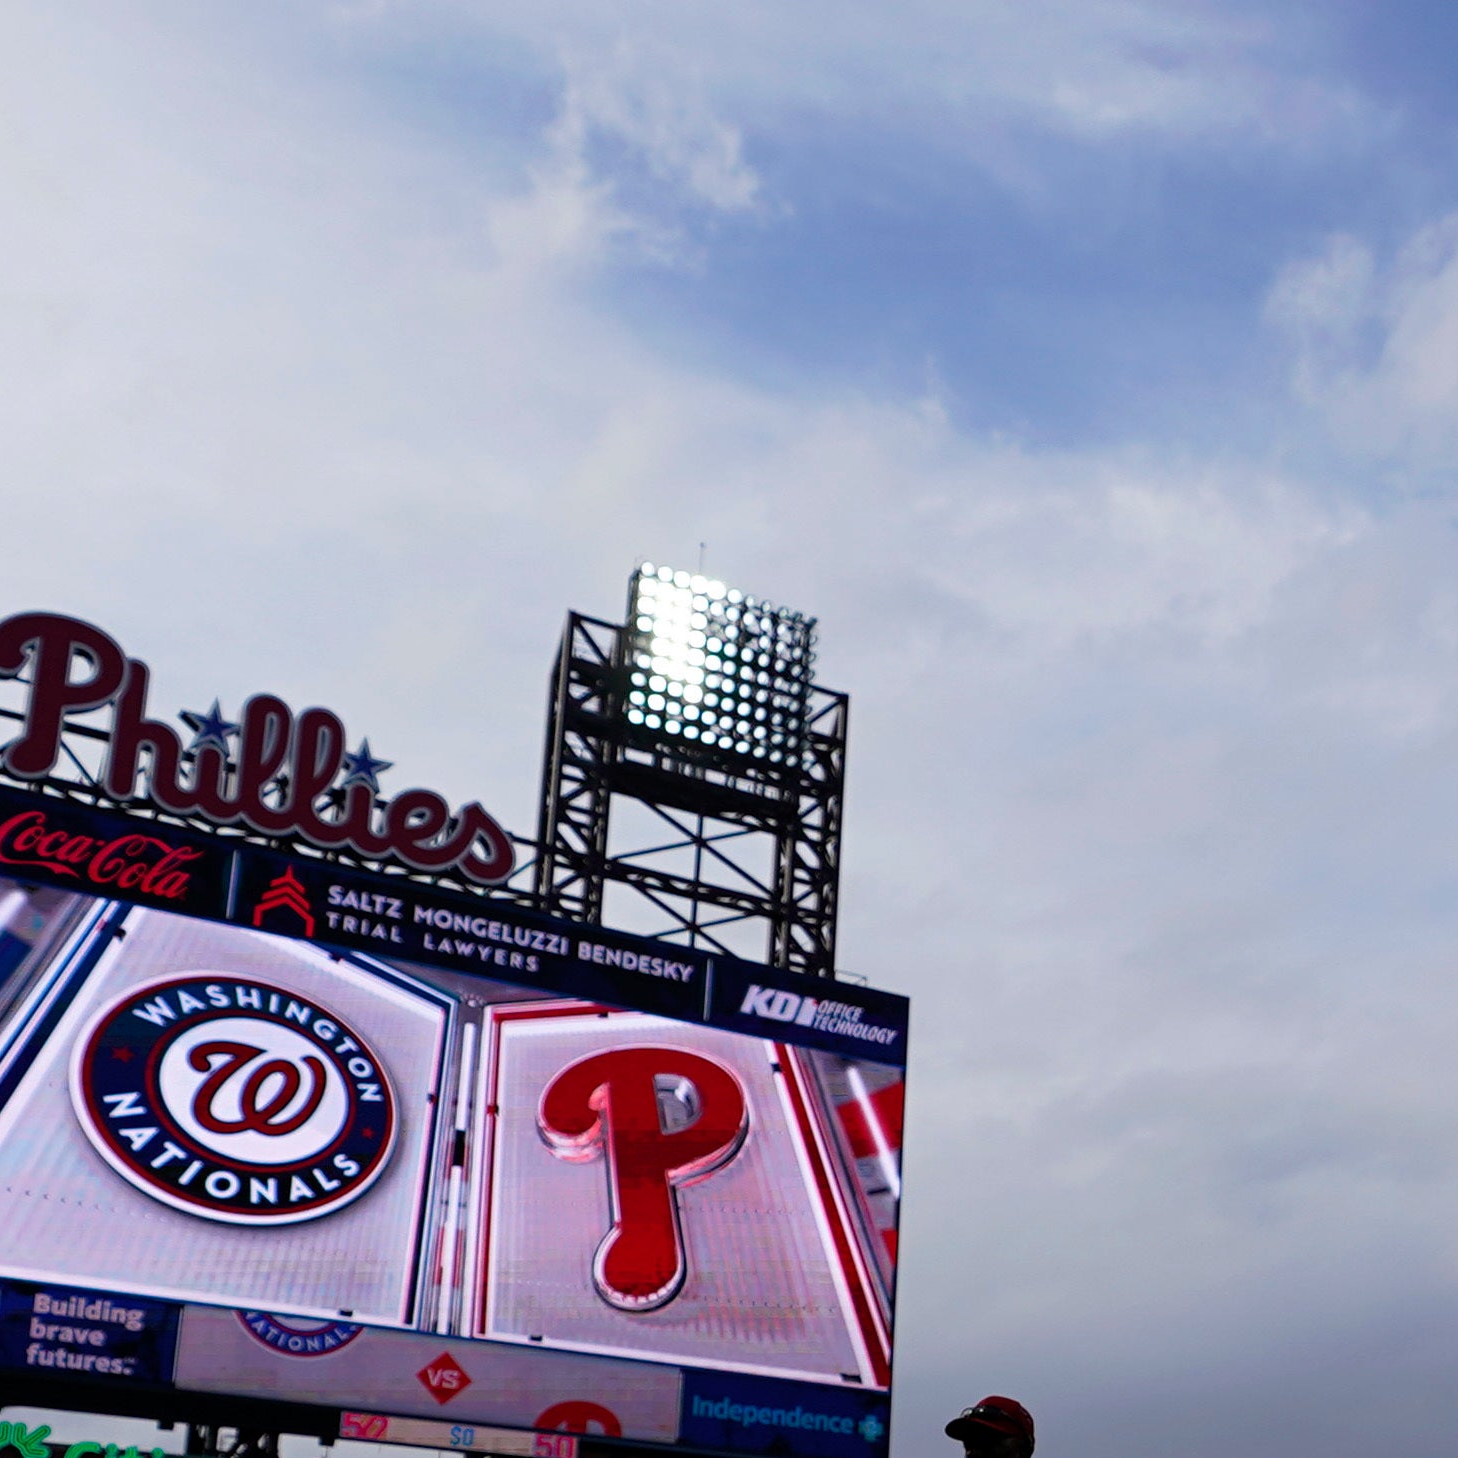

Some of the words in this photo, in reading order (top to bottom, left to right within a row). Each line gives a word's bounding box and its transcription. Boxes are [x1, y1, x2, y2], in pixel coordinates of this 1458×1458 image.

[327, 885, 402, 919] SALTZ
[414, 905, 568, 956] MONGELUZZI
[577, 942, 695, 983] BENDESKY
[327, 911, 403, 943] TRIAL
[423, 933, 540, 973] LAWYERS
[814, 1015, 898, 1045] TECHNOLOGY
[817, 1000, 865, 1022] OFFICE
[132, 985, 384, 1101] WASHINGTON
[103, 1092, 360, 1204] NATIONALS
[536, 1042, 750, 1312] P
[29, 1316, 107, 1347] brave
[32, 1293, 146, 1331] Building
[26, 1342, 135, 1376] futures.
[427, 1367, 460, 1390] VS
[692, 1395, 854, 1435] Independence
